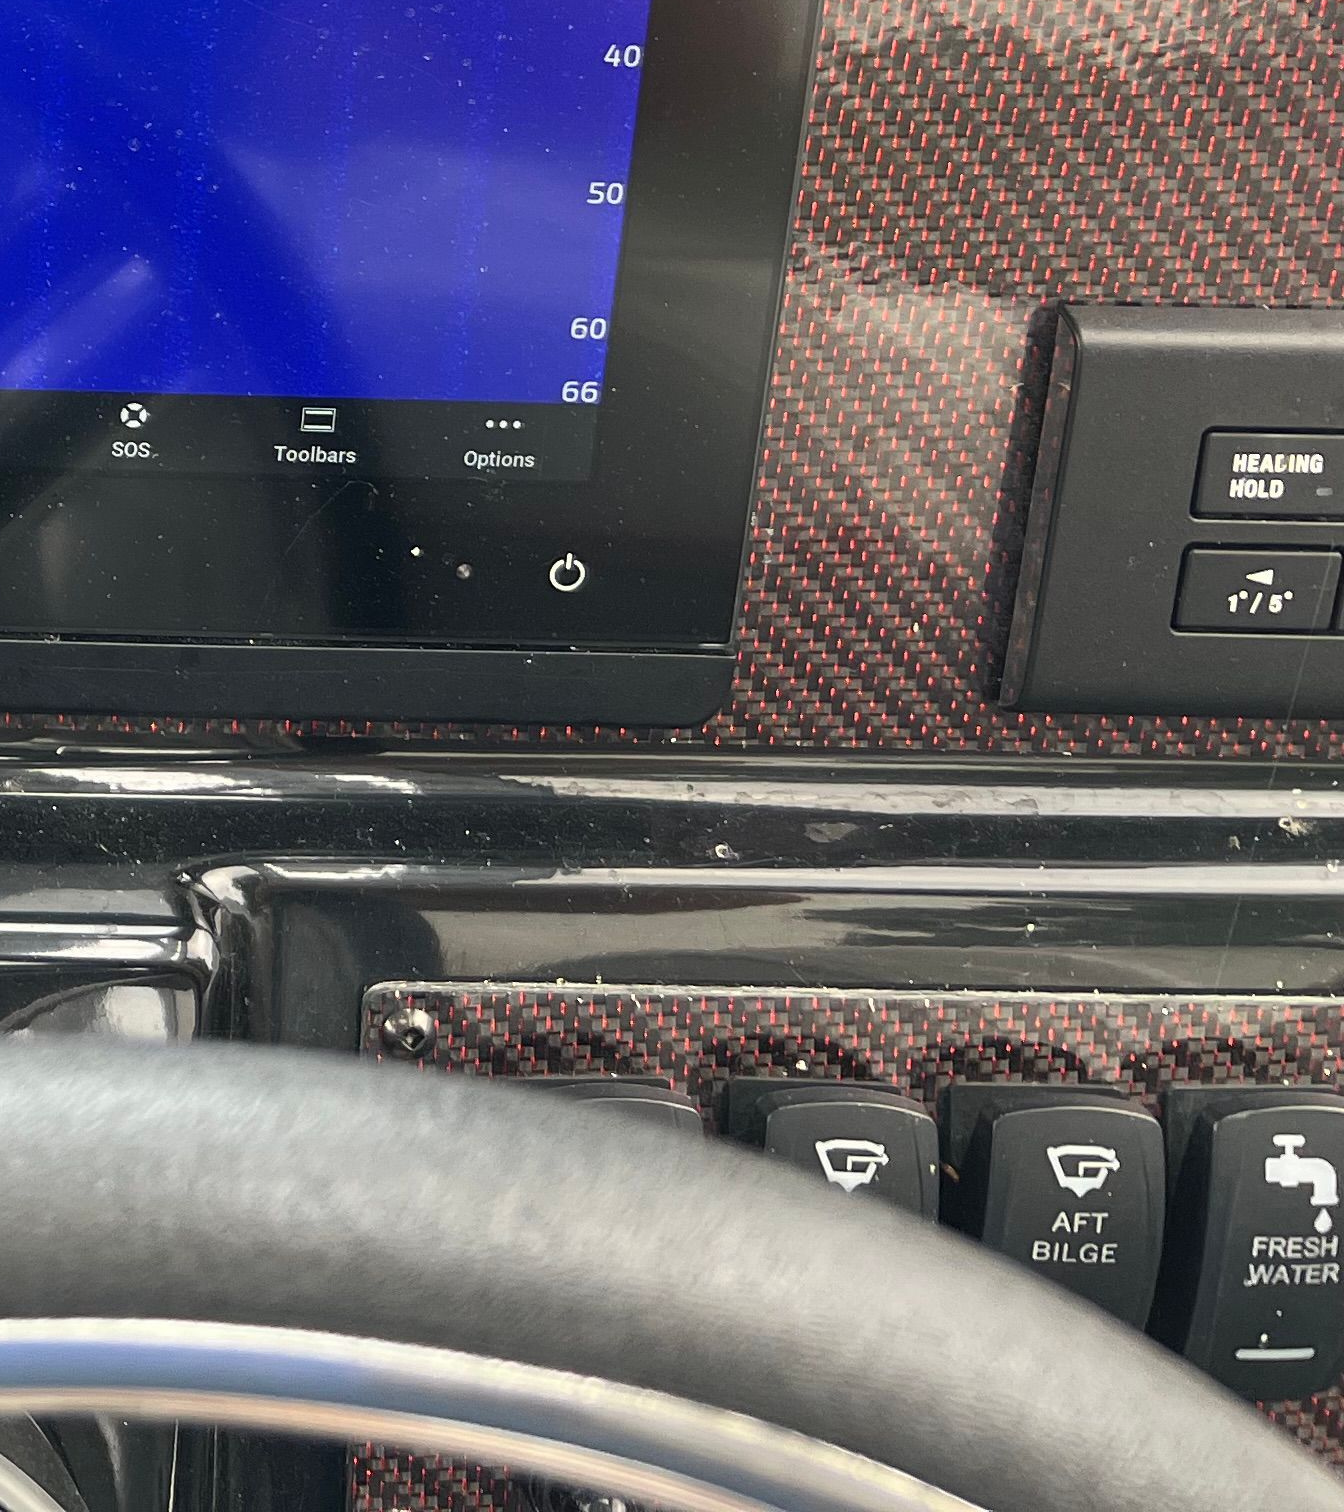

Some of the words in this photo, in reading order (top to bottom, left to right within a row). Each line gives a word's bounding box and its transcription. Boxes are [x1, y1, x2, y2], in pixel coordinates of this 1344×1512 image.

[604, 45, 641, 68] 40
[587, 182, 624, 205] 50
[570, 317, 607, 340] 60
[561, 380, 599, 403] 66
[111, 441, 151, 459] SOS
[273, 445, 357, 464] Toolbars
[463, 449, 535, 471] Options
[1232, 452, 1324, 474] HEADING
[1229, 478, 1284, 499] HOLD
[1051, 1211, 1109, 1234] AFT
[1031, 1241, 1118, 1265] BILGE
[1251, 1236, 1340, 1258] FRESH
[1250, 1263, 1340, 1285] WATER
